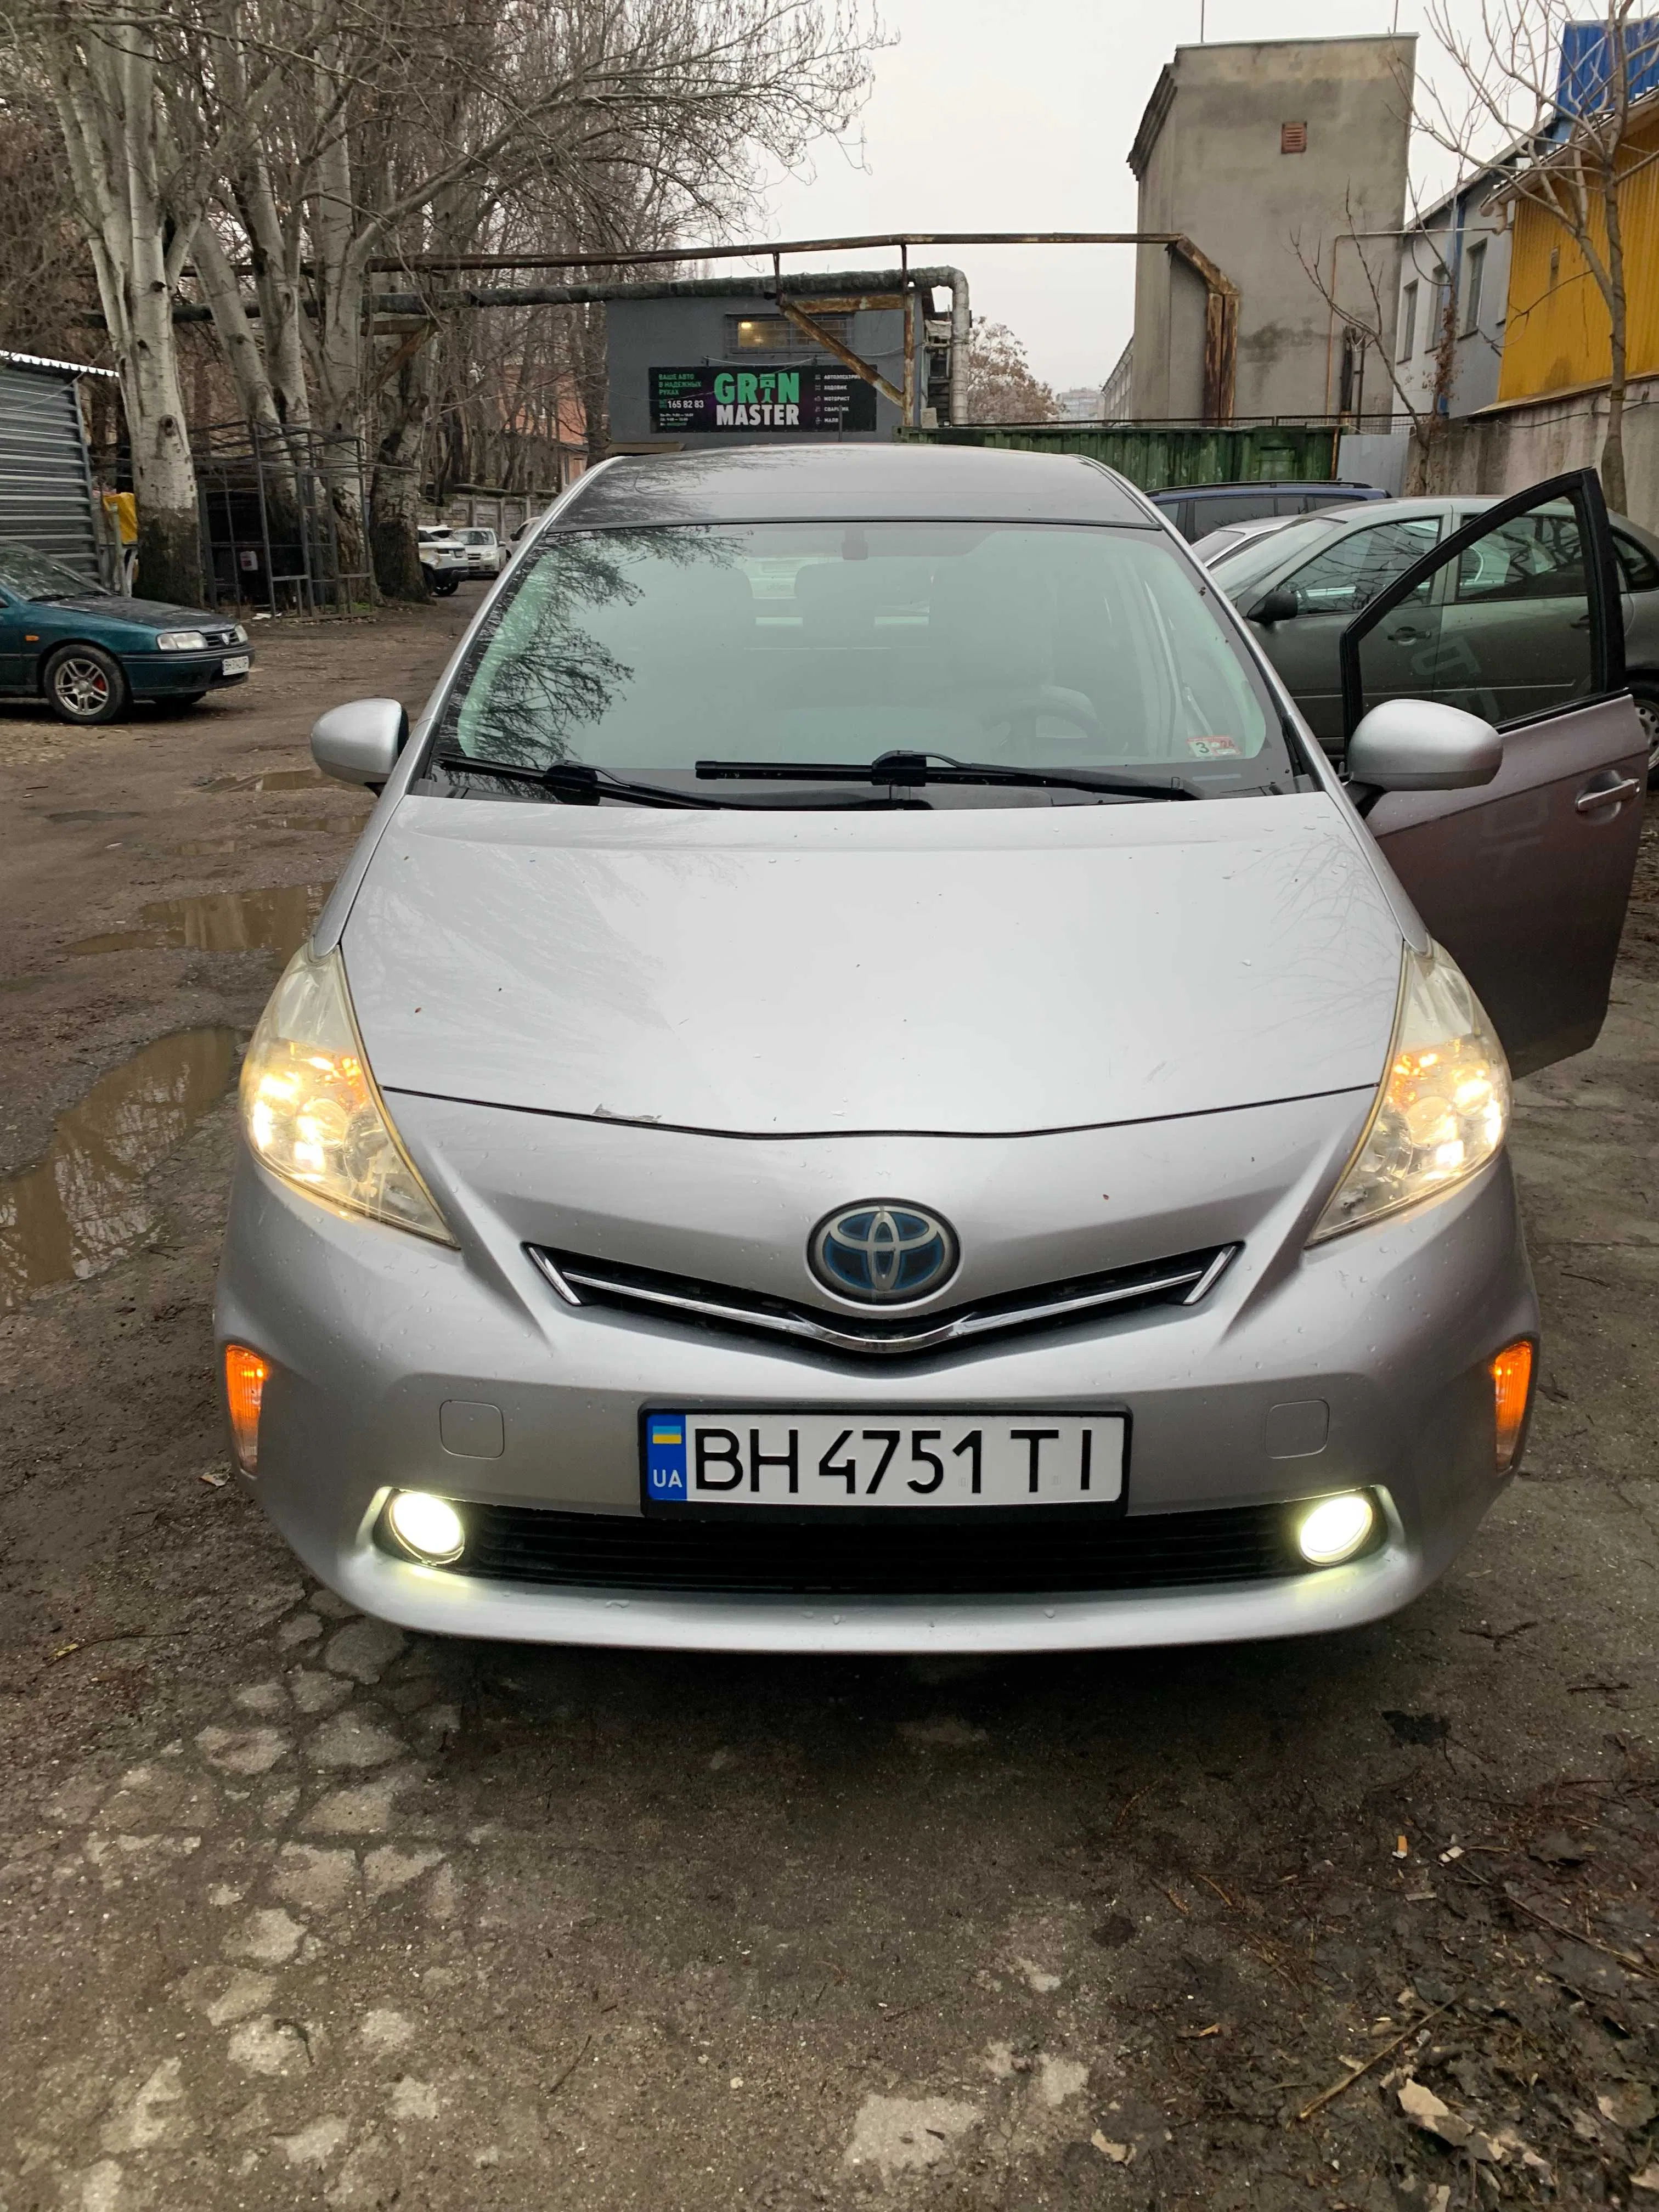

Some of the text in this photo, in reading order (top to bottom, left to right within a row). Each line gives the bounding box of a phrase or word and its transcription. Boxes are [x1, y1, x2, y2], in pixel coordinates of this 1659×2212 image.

[668, 400, 681, 408] 165
[683, 400, 693, 408] 82
[694, 400, 704, 408] 83
[716, 404, 799, 426] MASTER
[1195, 742, 1210, 753] 3
[695, 1429, 1092, 1494] BH 4751 TI
[653, 1469, 682, 1488] UA
